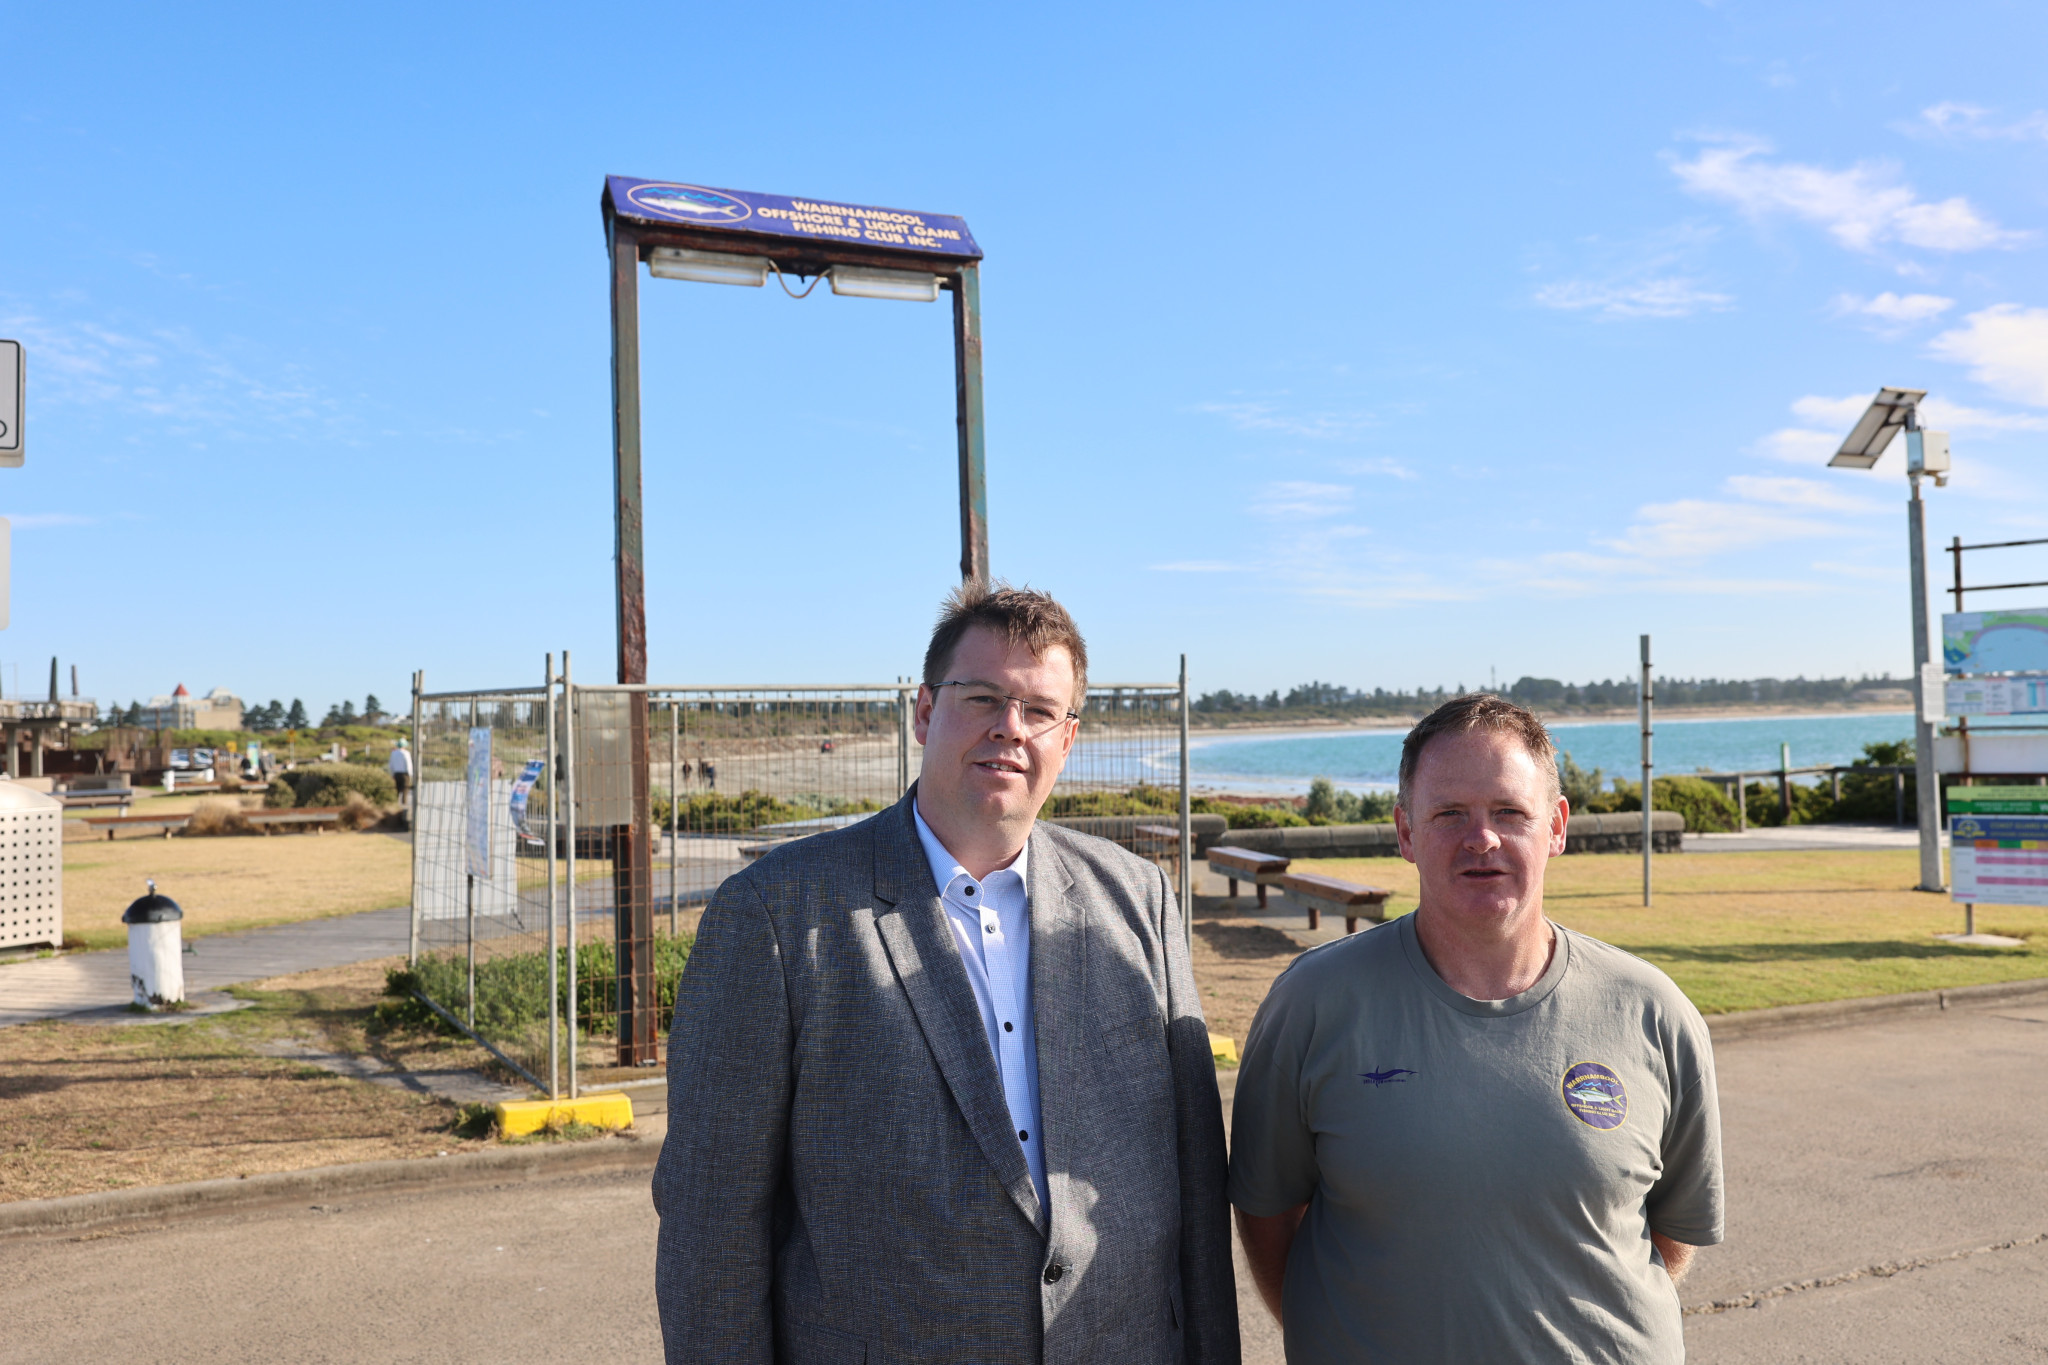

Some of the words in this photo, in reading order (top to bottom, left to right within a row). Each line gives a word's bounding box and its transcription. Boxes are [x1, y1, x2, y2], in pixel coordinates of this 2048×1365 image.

[757, 207, 844, 227] OFFSHORE
[847, 216, 862, 229] &
[864, 219, 911, 235] LIGHT
[913, 226, 961, 241] GAME
[791, 200, 926, 227] WARRNAMBOOL
[792, 222, 861, 239] FISHING
[864, 231, 905, 244] CLUB
[907, 235, 943, 248] INC.
[1565, 1073, 1620, 1089] WARRNAMBOOL
